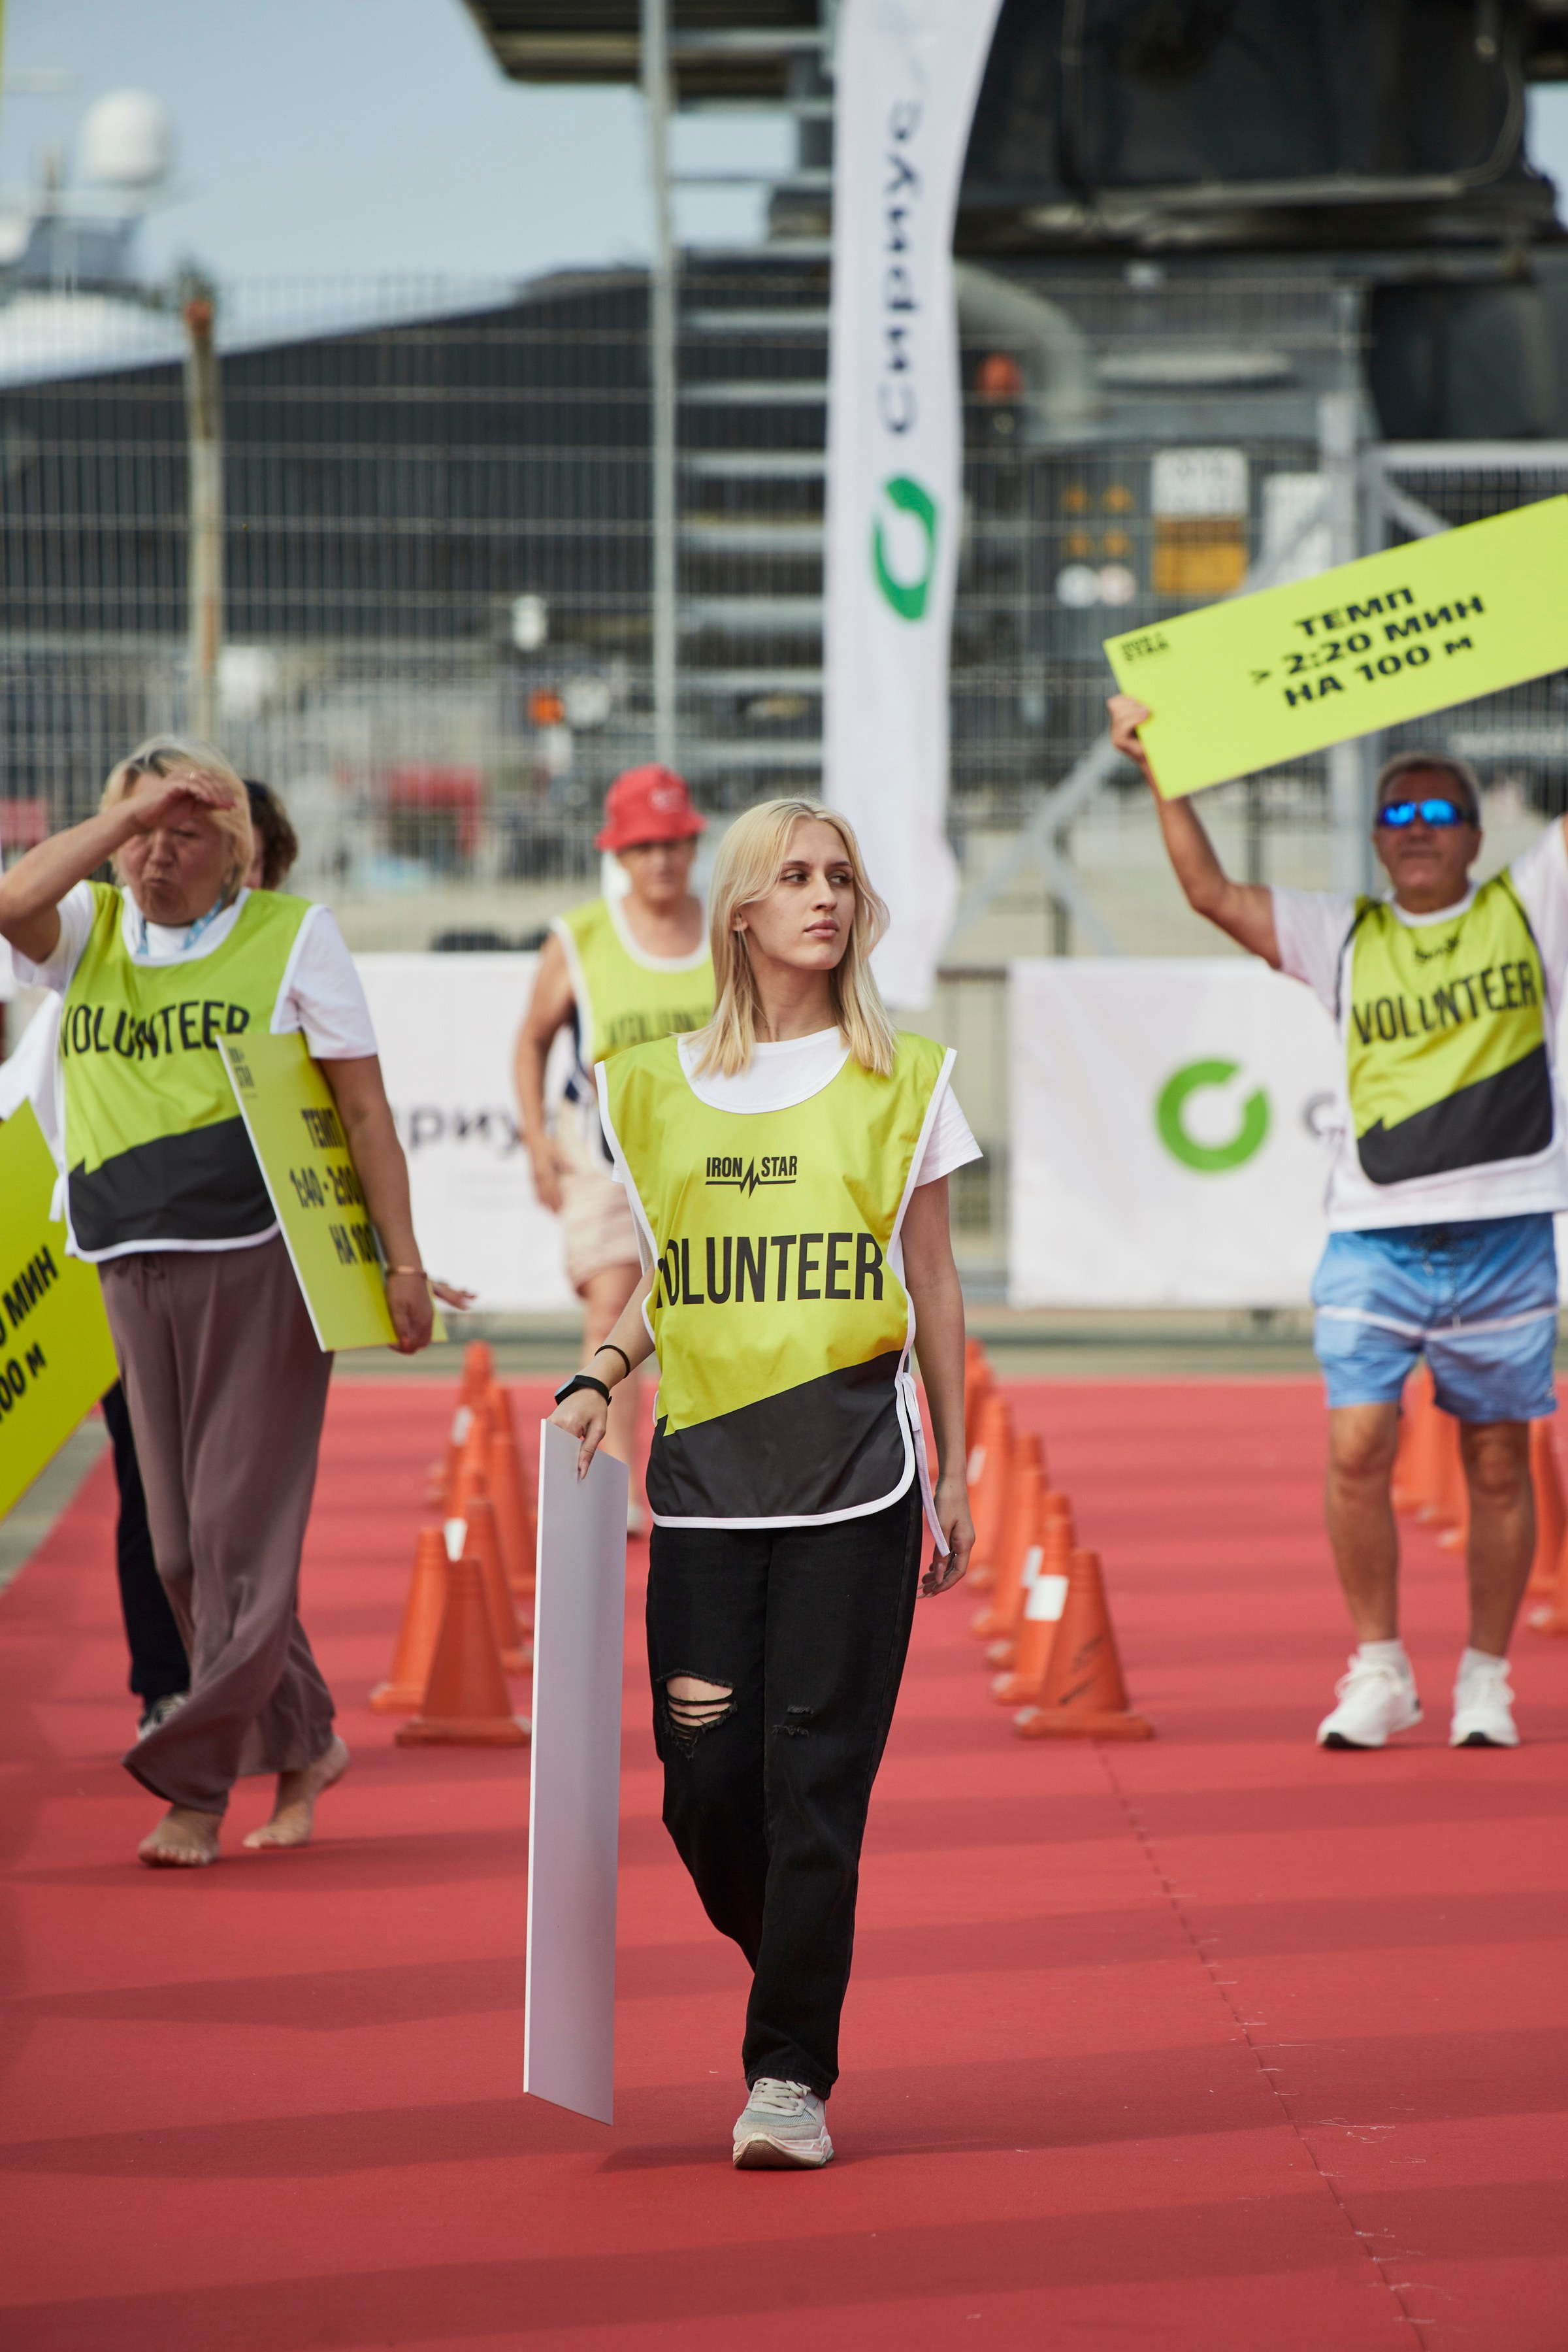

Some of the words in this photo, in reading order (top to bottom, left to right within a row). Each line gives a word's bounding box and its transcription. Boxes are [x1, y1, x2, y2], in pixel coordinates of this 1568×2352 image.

[1282, 633, 1373, 675] 2:20
[1384, 595, 1485, 642] МИН
[1294, 587, 1414, 636] ТЕМП
[1284, 675, 1345, 708] НА
[1355, 645, 1431, 681] 100
[706, 1157, 743, 1177] IRON
[761, 1155, 798, 1177] STAR
[3, 1243, 59, 1330] МИН
